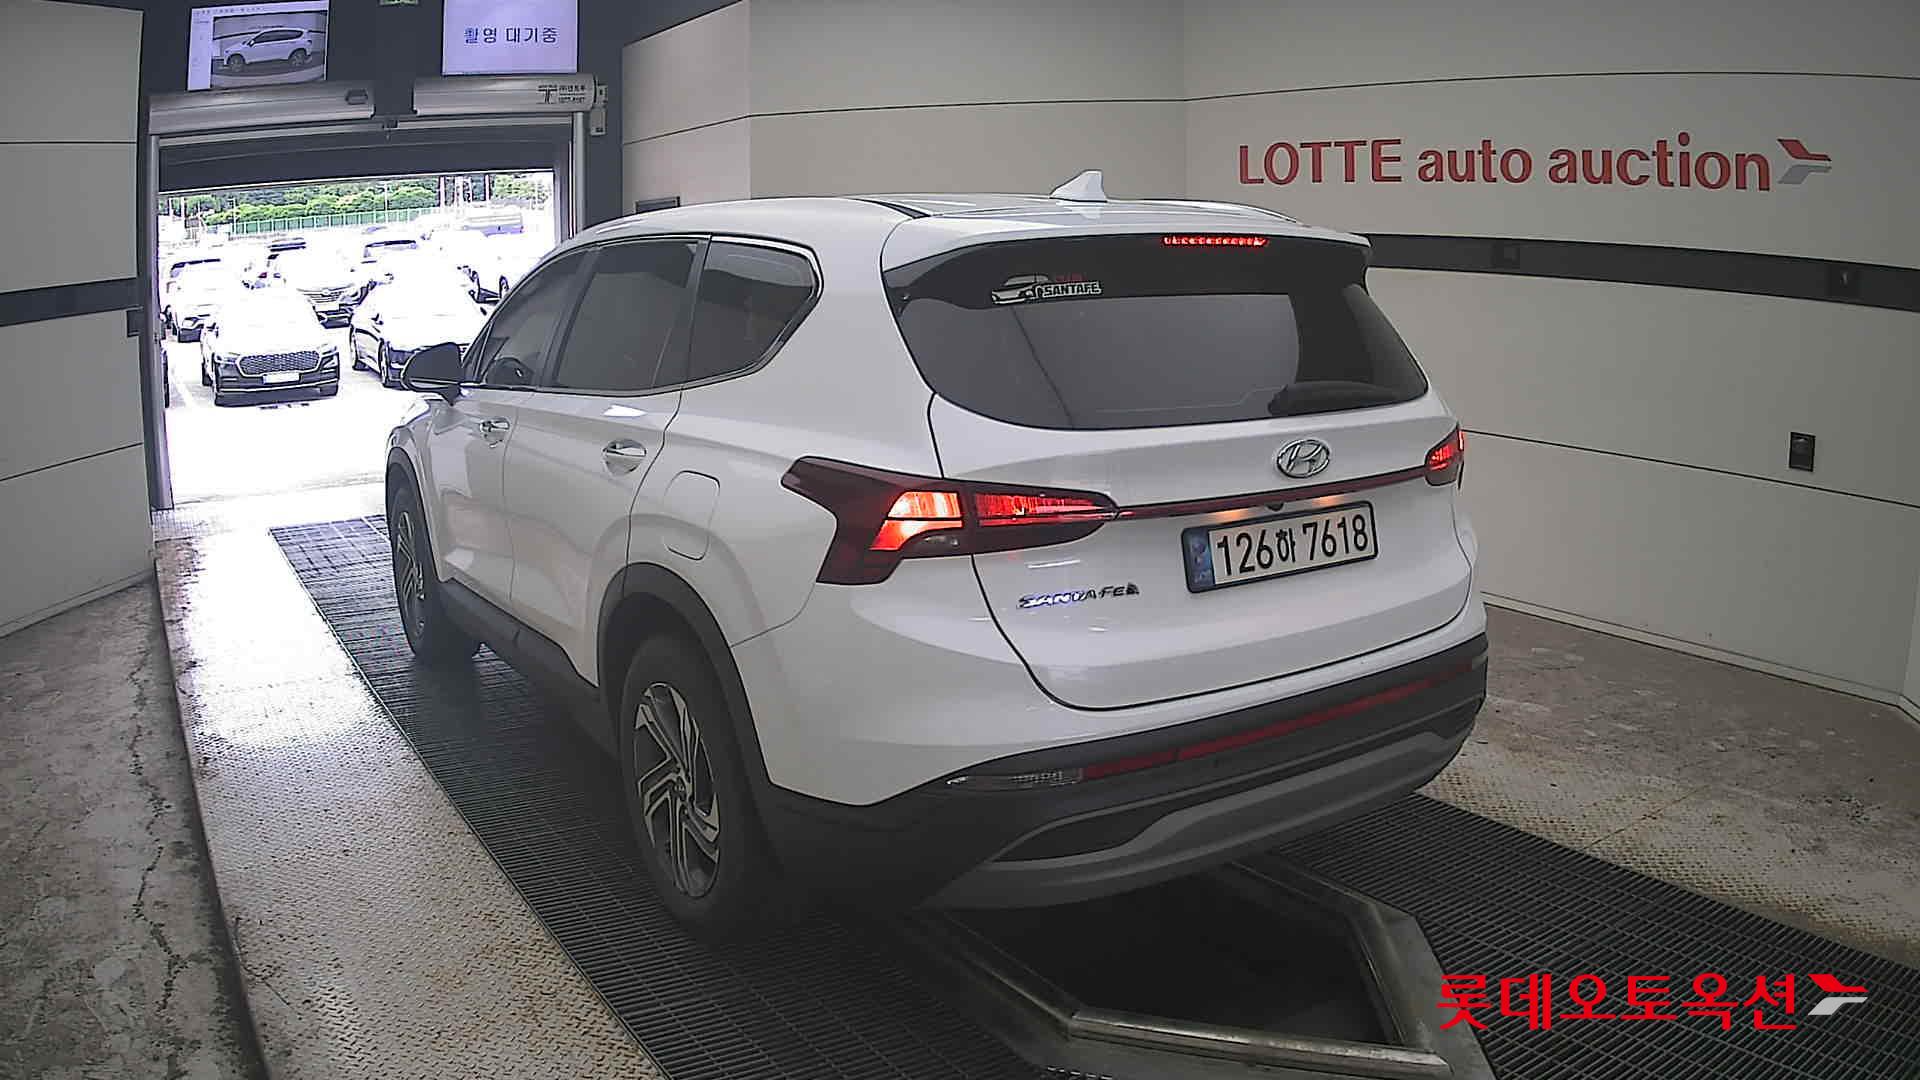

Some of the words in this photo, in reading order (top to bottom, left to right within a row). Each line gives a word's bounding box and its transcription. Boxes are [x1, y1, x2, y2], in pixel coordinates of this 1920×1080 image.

[505, 27, 558, 44] 대기중
[1240, 138, 1401, 184] LOTTE
[1417, 139, 1533, 185] auto
[1547, 132, 1771, 191] auction
